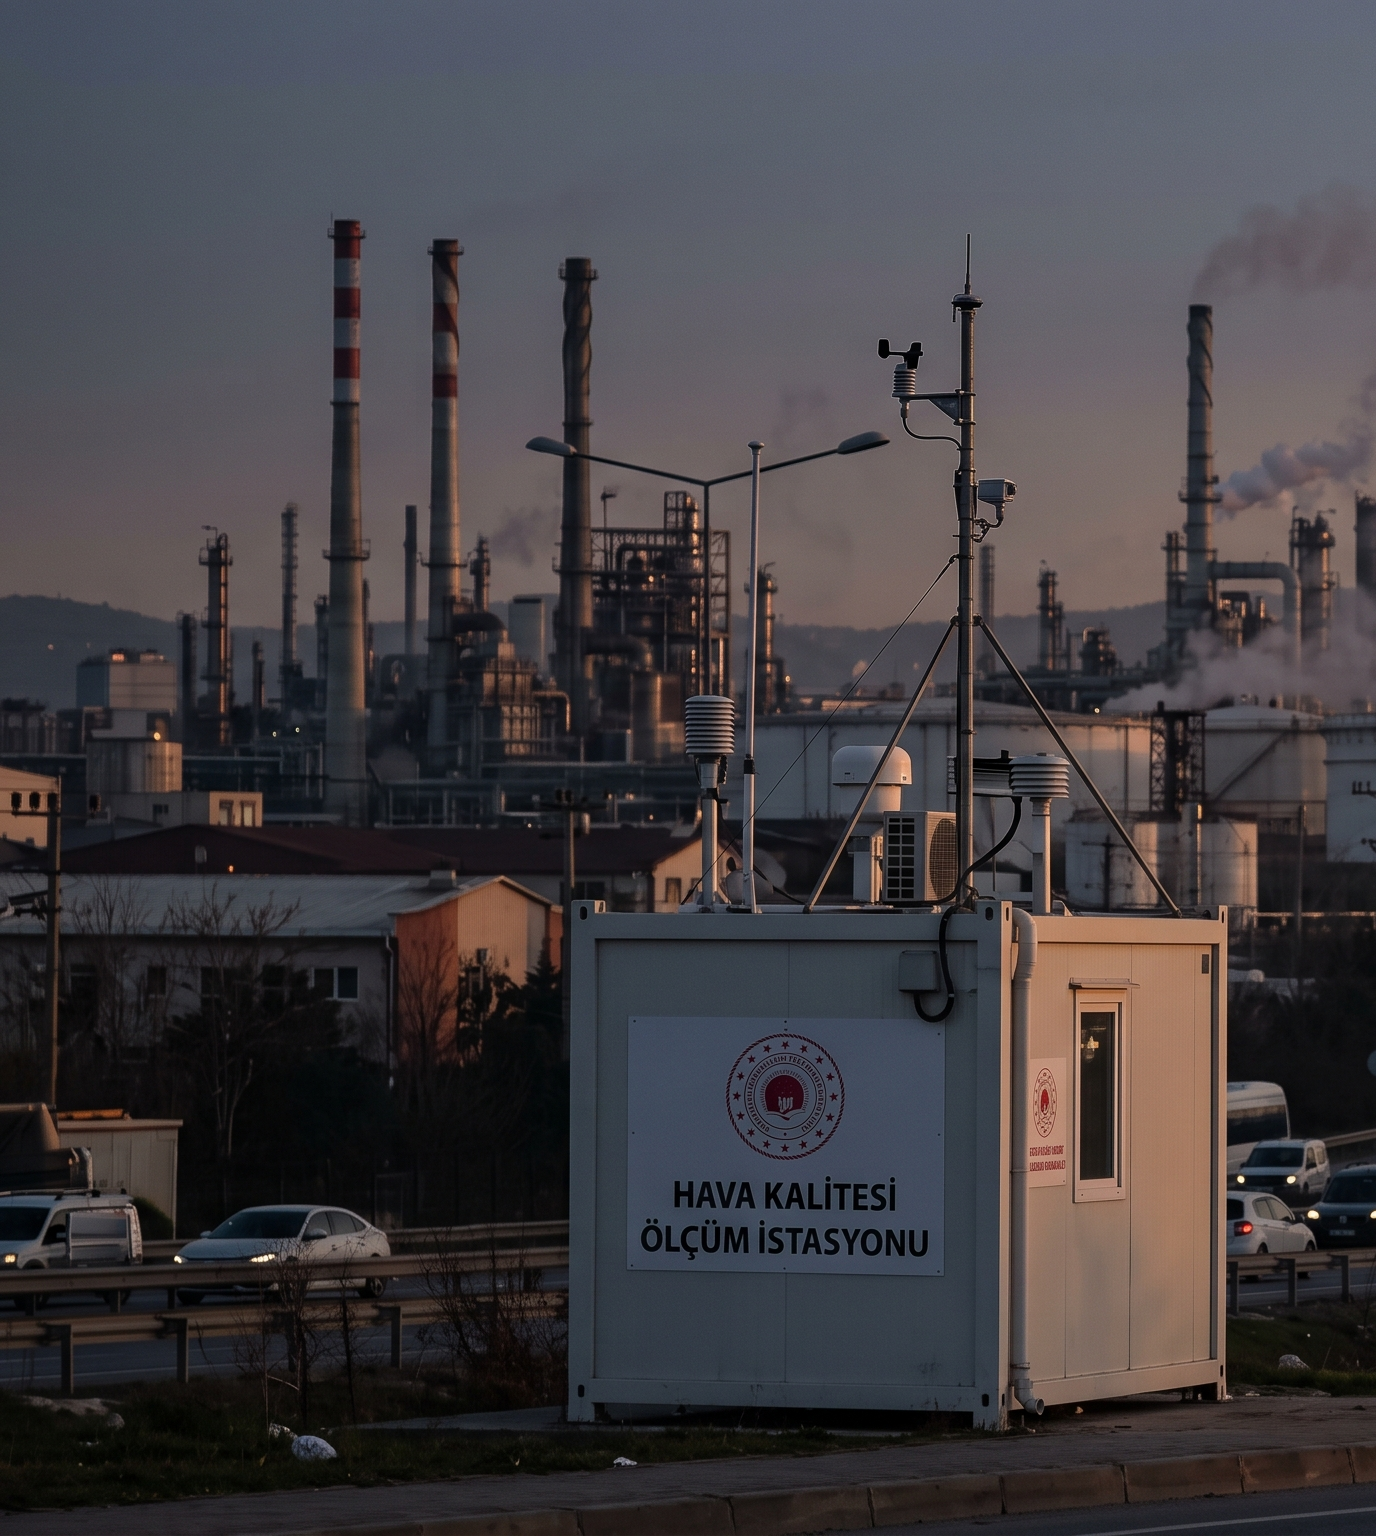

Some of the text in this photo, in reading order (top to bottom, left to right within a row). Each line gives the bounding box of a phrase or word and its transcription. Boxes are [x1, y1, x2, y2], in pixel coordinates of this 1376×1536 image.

[673, 1176, 896, 1212] HAVA KALİTESİ
[640, 1217, 929, 1261] ÖLÇÜM İSTASYONU
